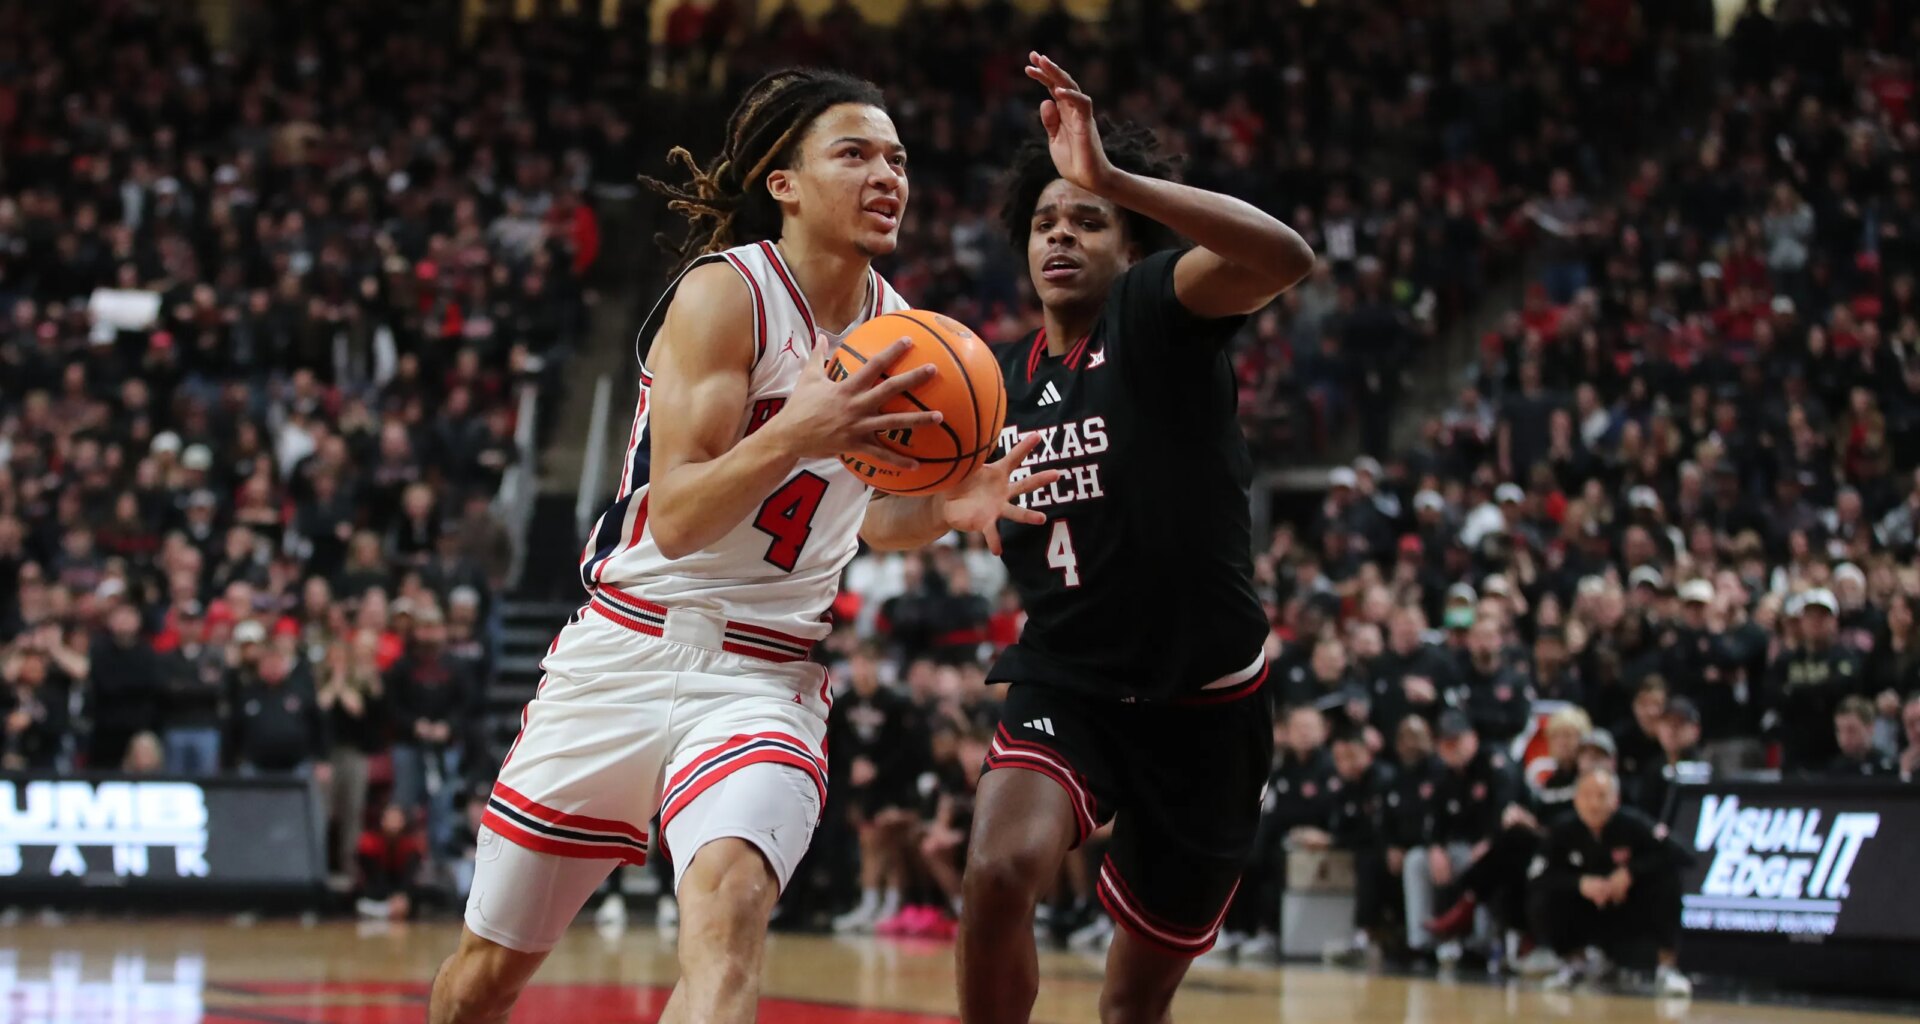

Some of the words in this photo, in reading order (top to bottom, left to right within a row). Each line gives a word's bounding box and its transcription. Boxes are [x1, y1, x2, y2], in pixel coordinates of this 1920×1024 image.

[998, 416, 1109, 467] TEXAS
[753, 469, 830, 574] 4
[1046, 518, 1081, 588] 4
[0, 780, 208, 829] UMB
[1694, 794, 1824, 853] VISUAL
[1701, 850, 1813, 899] EDGE
